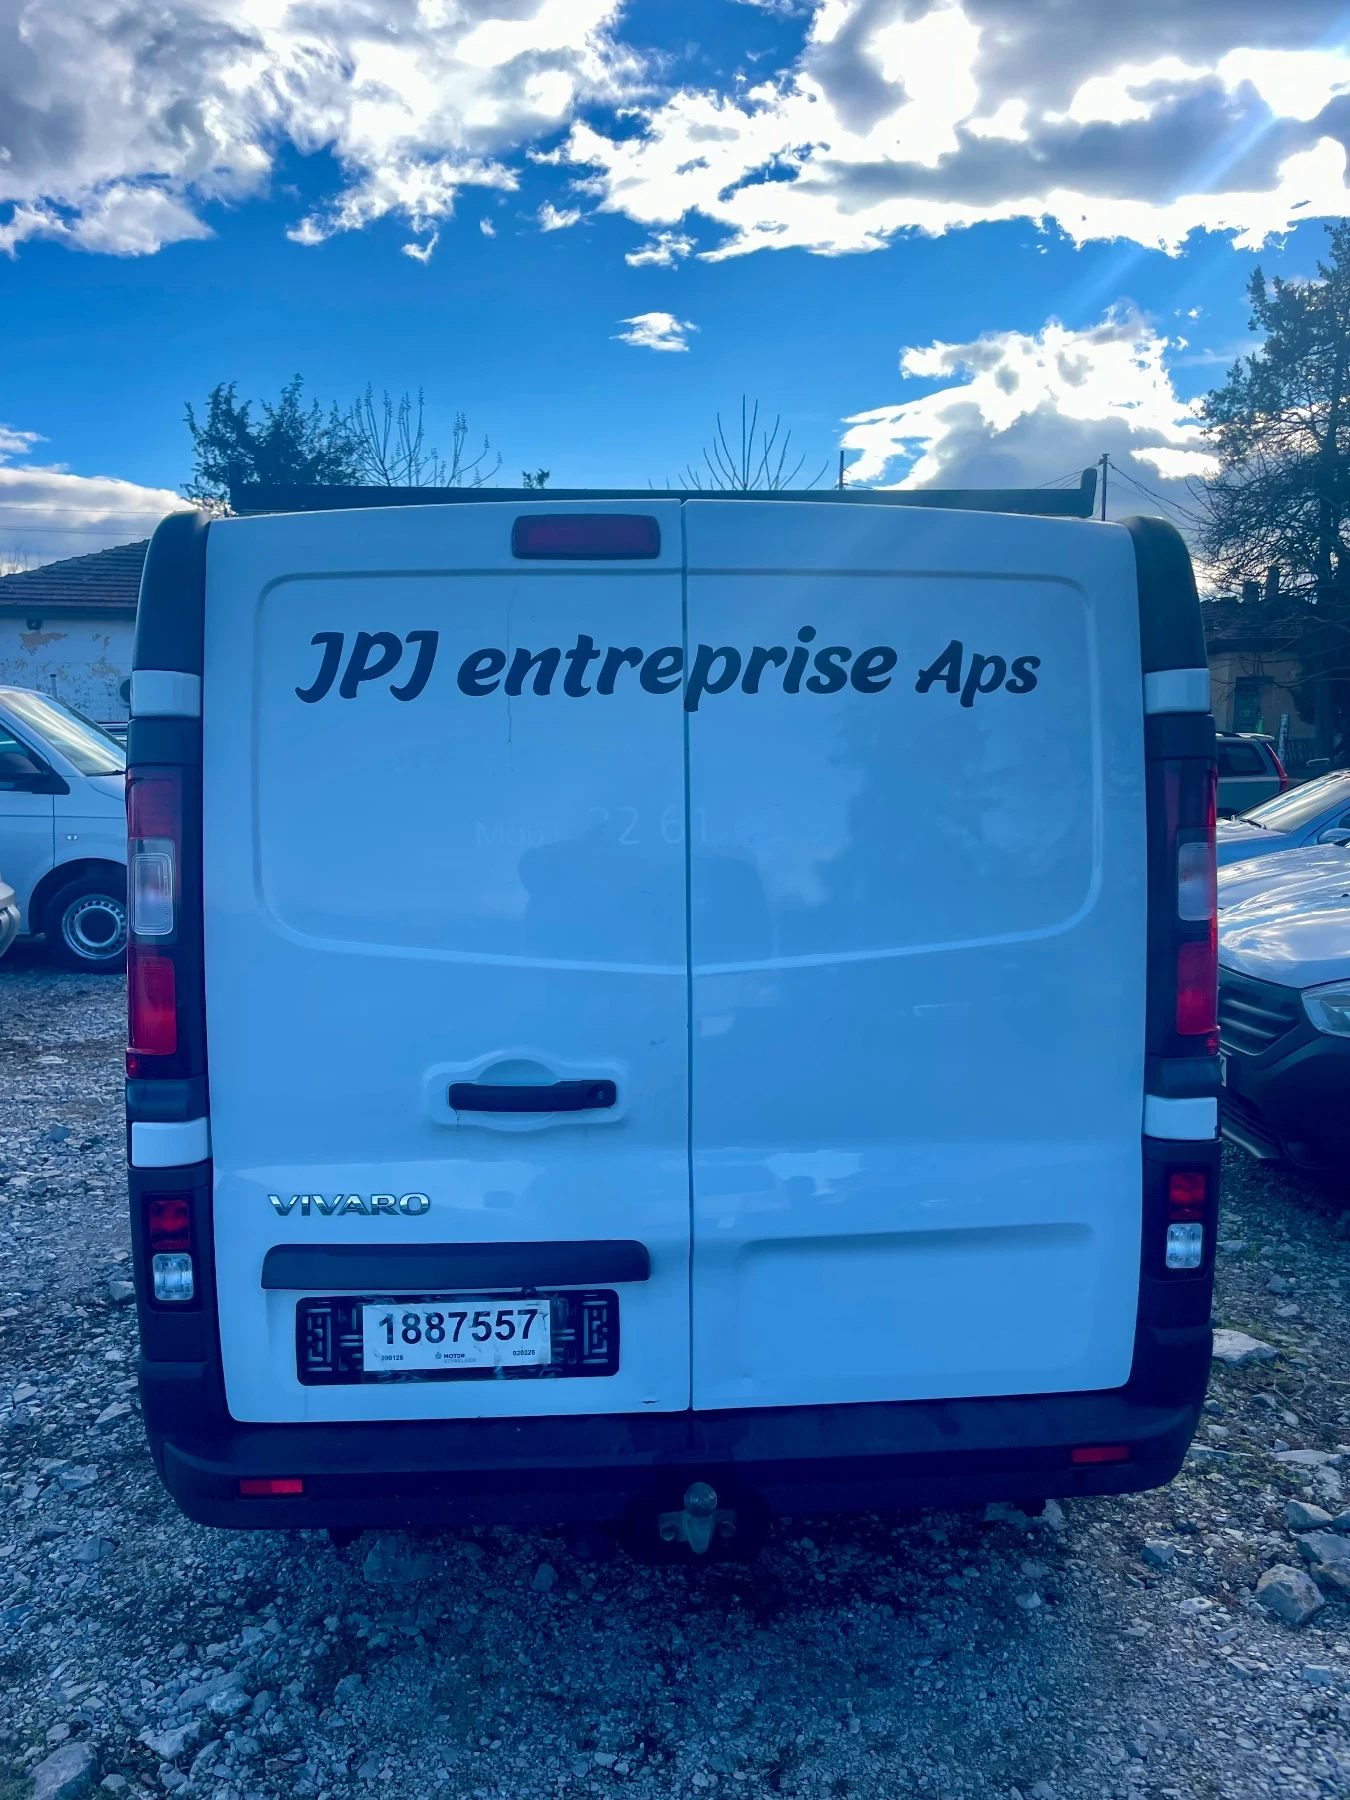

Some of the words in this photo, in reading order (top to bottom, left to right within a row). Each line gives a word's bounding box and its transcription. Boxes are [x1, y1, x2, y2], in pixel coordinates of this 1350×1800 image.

[294, 630, 439, 704] JPJ
[457, 625, 898, 713] entreprise
[914, 639, 1041, 708] Aps
[267, 1191, 431, 1217] VIVARO
[379, 1308, 538, 1345] 1887557
